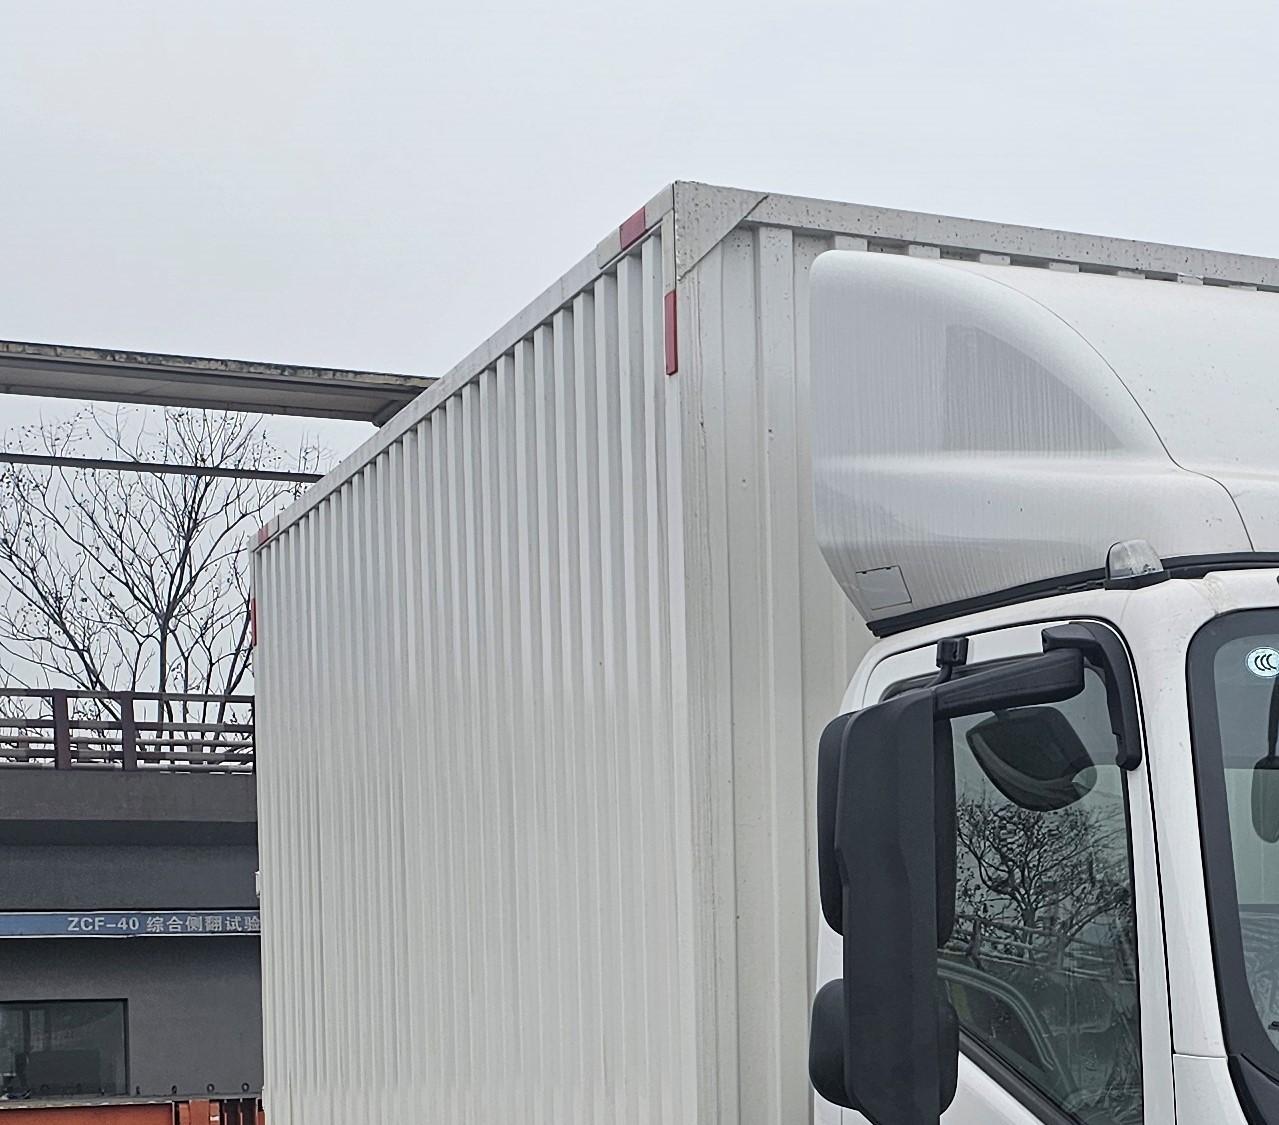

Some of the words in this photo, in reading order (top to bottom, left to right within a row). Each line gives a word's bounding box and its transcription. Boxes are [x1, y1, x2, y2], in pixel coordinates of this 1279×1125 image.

[67, 917, 139, 931] ZCF-40
[146, 915, 261, 932] 综合侧翻试验
